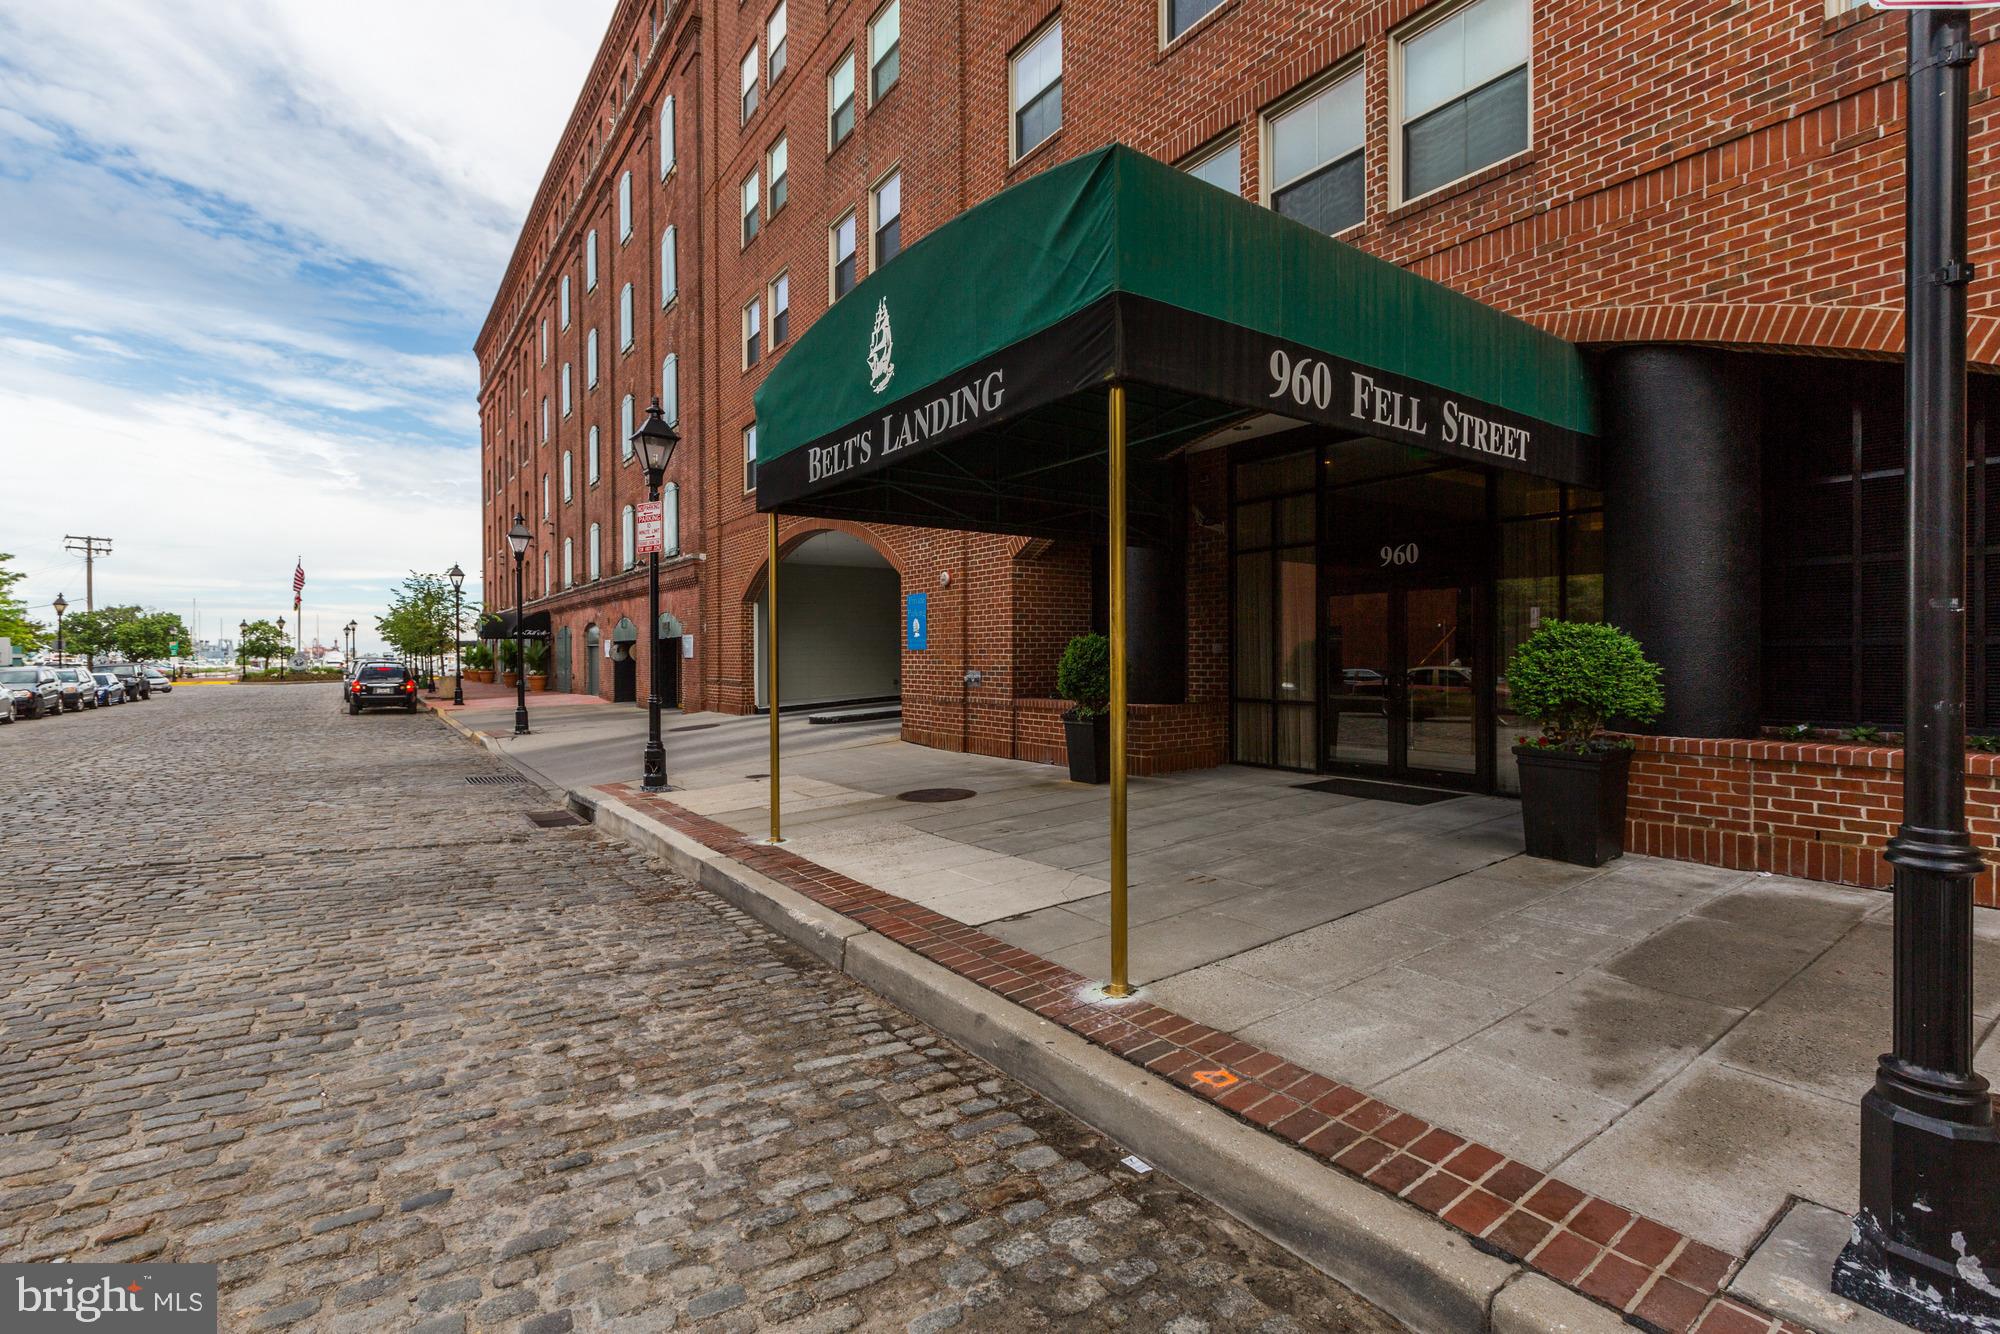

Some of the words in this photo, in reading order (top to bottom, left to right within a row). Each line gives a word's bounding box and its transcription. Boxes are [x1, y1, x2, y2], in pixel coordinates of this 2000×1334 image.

[808, 429, 872, 483] BELT'S
[881, 368, 1005, 456] LANDING
[1269, 349, 1332, 410] 960
[1350, 370, 1427, 435] FELL
[1441, 400, 1530, 462] STREET
[638, 514, 661, 523] PARKING
[1380, 543, 1419, 567] 960
